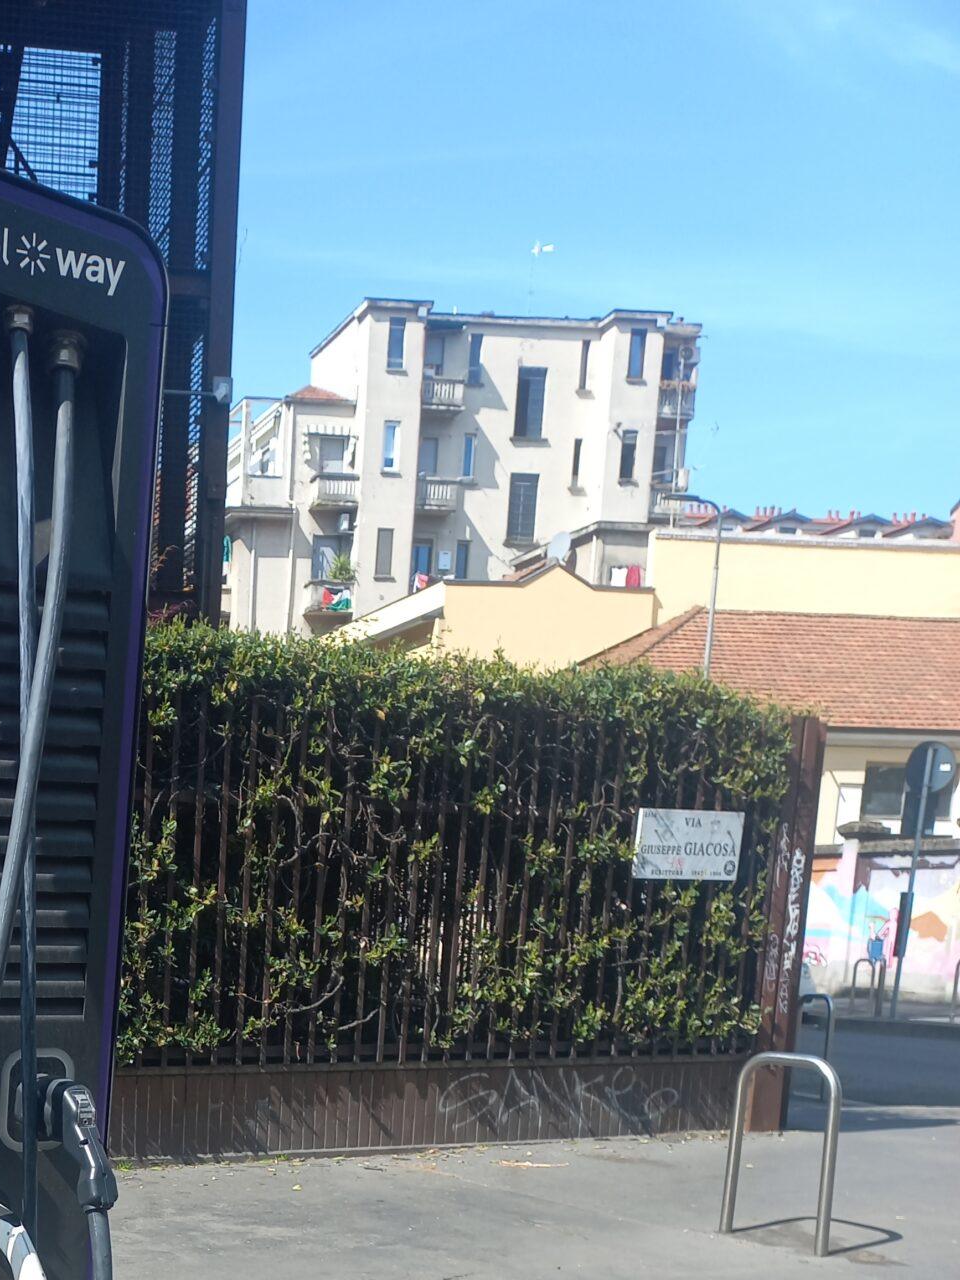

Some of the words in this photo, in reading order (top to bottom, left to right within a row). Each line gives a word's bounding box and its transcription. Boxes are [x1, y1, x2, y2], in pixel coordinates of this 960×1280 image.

[55, 247, 126, 296] way
[684, 817, 703, 828] VIA
[640, 844, 682, 856] GIUSEPPE
[684, 841, 737, 858] GIACOSA
